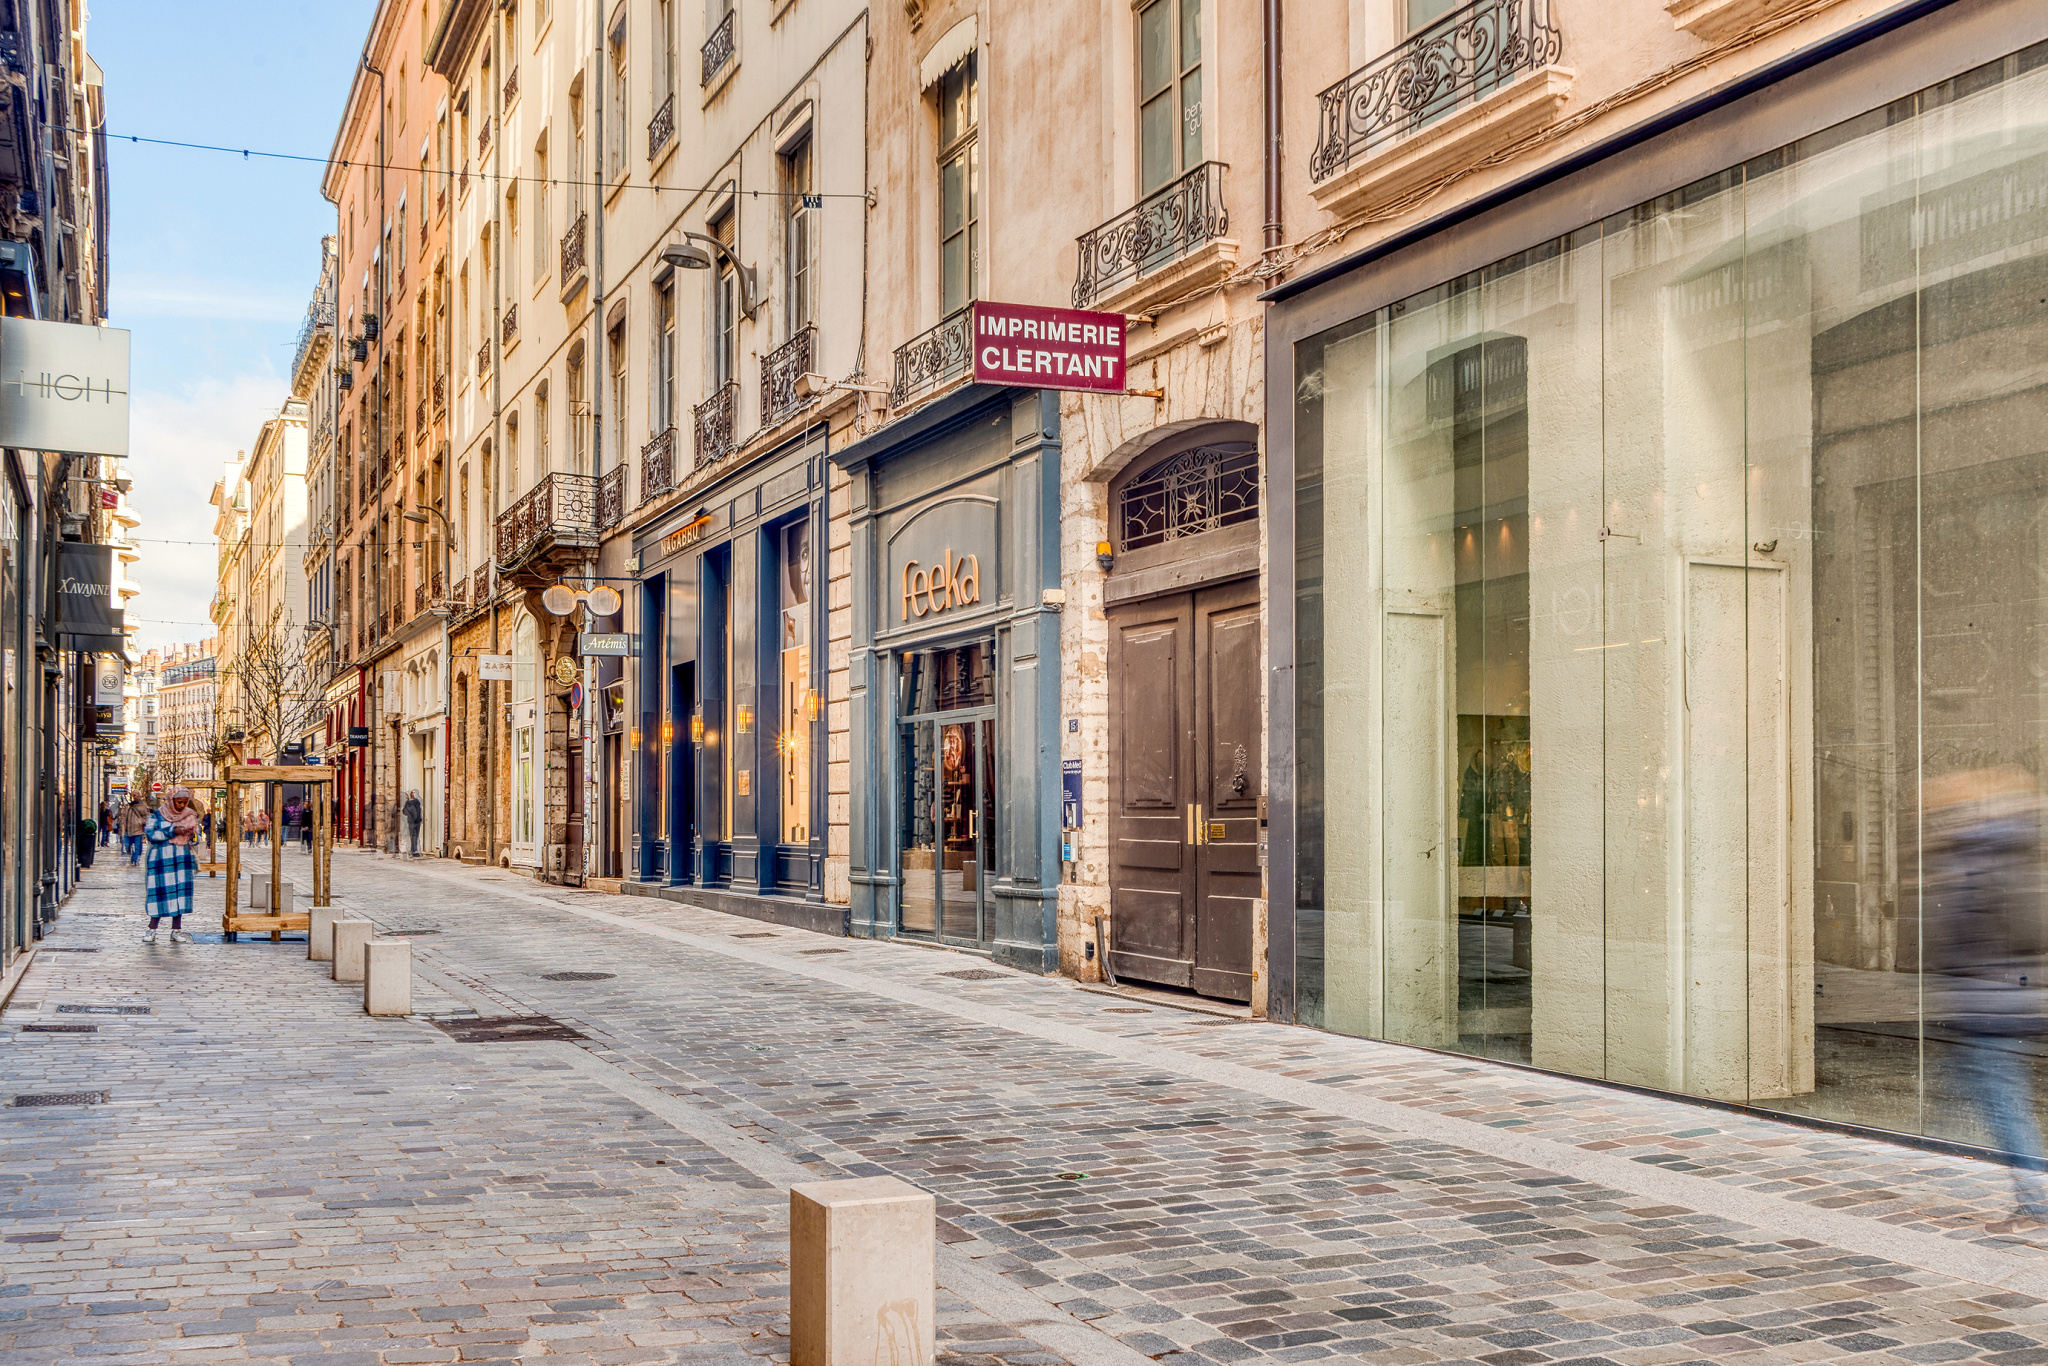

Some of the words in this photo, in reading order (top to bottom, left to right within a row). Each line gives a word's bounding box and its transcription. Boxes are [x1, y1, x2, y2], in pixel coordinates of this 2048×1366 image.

[980, 315, 1120, 346] IMPRIMERIE
[981, 346, 1119, 379] CLERTANT
[901, 547, 980, 622] feeka
[583, 636, 627, 651] Artémis
